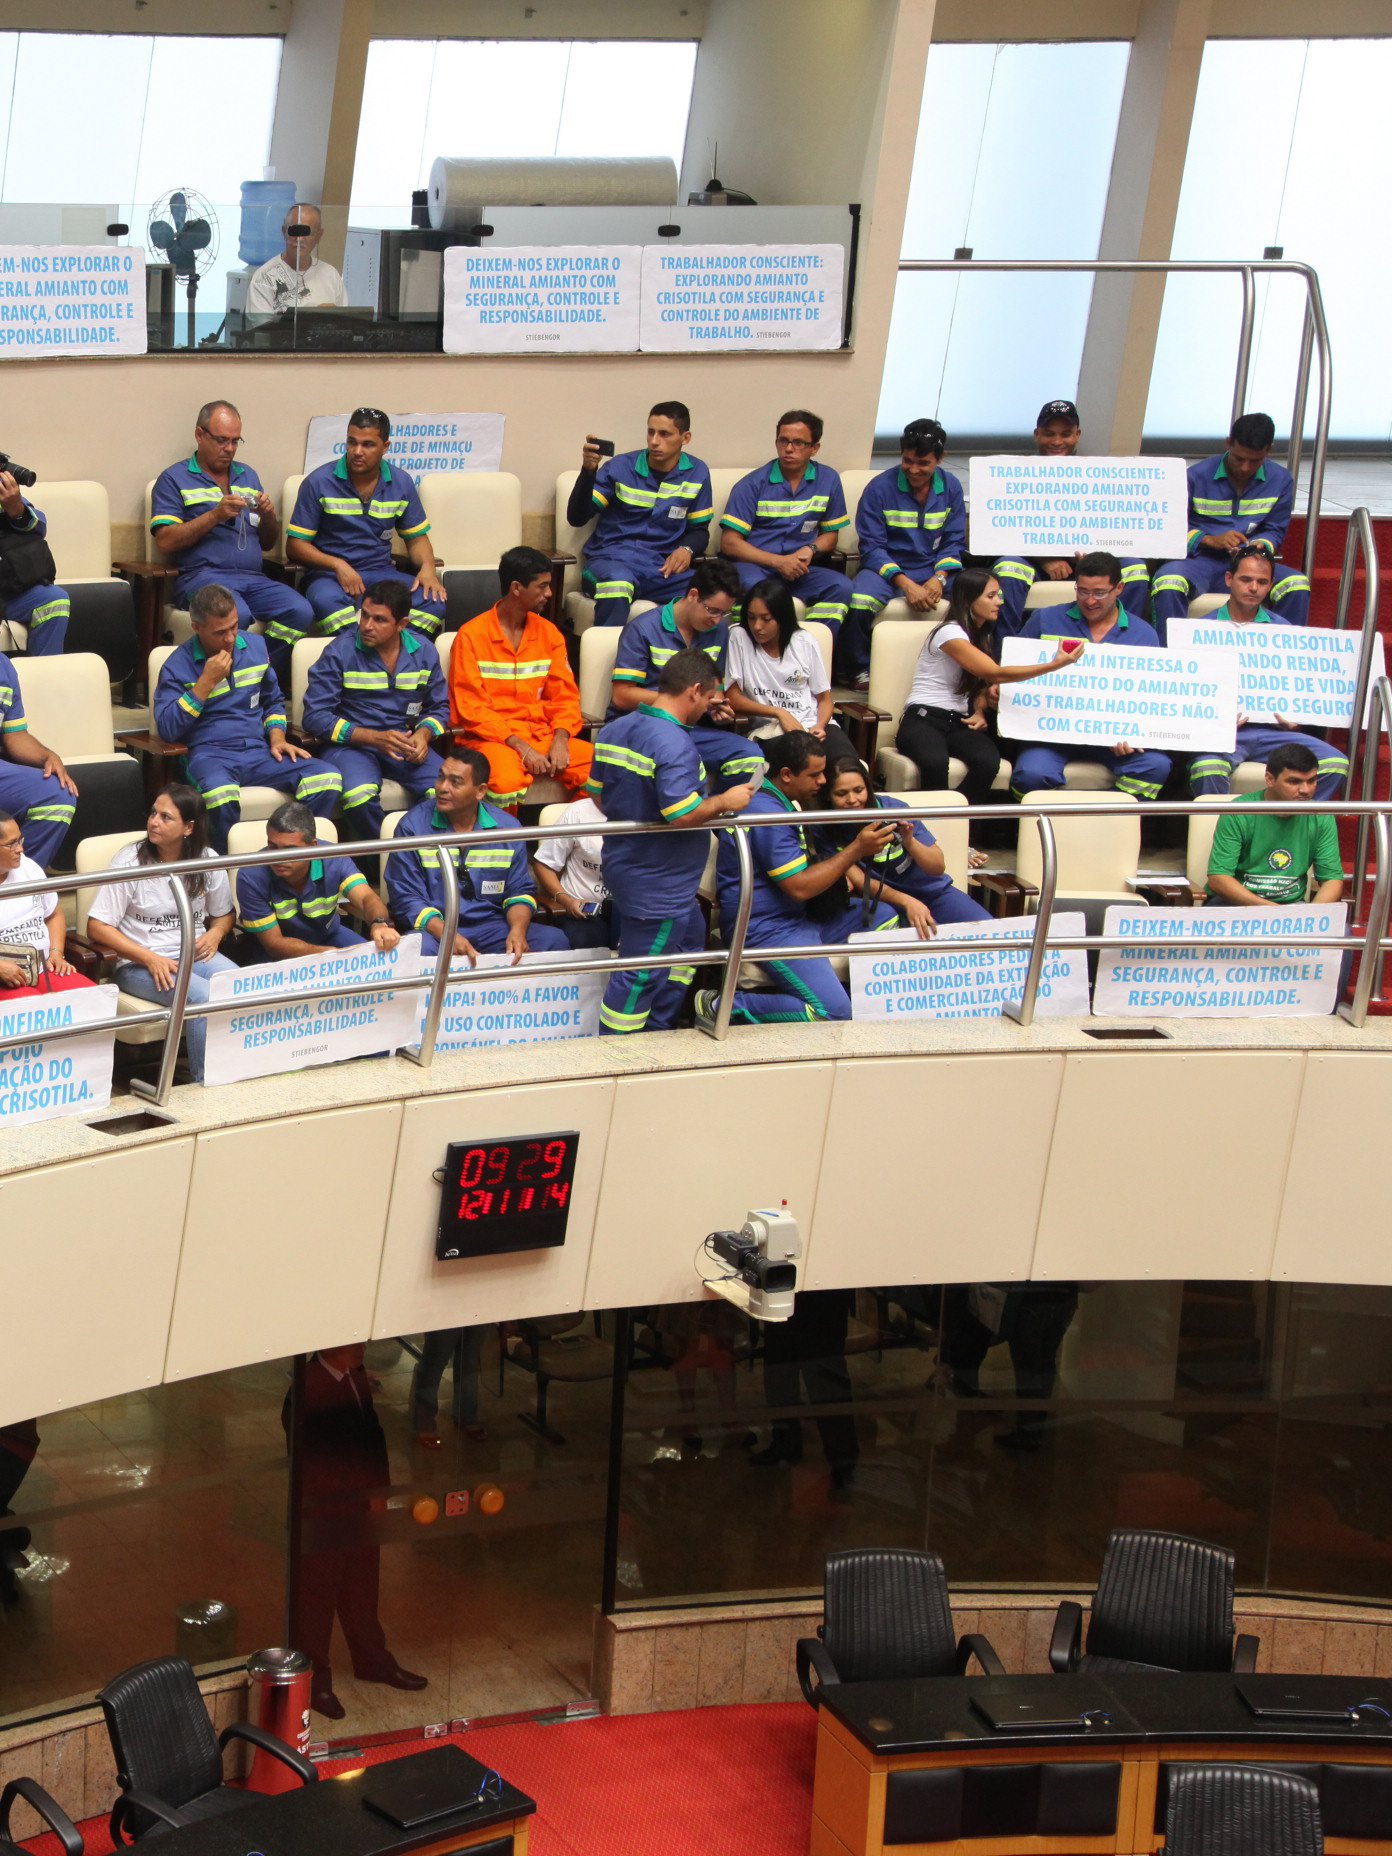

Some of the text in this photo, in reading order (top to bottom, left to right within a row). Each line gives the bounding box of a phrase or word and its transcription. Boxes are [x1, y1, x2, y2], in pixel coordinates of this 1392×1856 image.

[53, 256, 120, 272] EXPLORAR
[124, 256, 132, 271] O
[466, 257, 620, 271] DEIXEM-NOS EXPLORAR O
[660, 256, 823, 269] TRABALHADOR CONSCIENTE:
[470, 275, 616, 289] MINERAL AMIANTO COM
[675, 273, 808, 286] EXPLORANDO AMIANTO
[35, 280, 97, 296] AMIANTO
[101, 280, 128, 295] COM
[466, 292, 620, 309] SEGURANÇA, CONTROLE E
[657, 291, 824, 306] CRISOTILA COM SEGURANÇA E
[55, 304, 122, 319] CONTROLE
[127, 303, 133, 318] E
[480, 309, 606, 323] RESPONSABILIDADE.
[661, 308, 819, 321] CONTROLE DO AMBIENTE DE
[689, 326, 753, 338] TRABALHO.
[451, 425, 457, 436] E
[411, 441, 472, 456] DE MINAÇU
[400, 458, 447, 469] PROJETO
[451, 458, 465, 469] DE
[989, 466, 1165, 480] TRABALHADOR CONSCIENTE:
[1006, 483, 1150, 496] EXPLORANDO AMIANTO
[987, 499, 1168, 516] CRISOTILA COM SEGURANÇA E
[992, 516, 1163, 530] CONTROLE DO AMBIENTE DE
[1023, 533, 1093, 545] TRABALHO.
[1193, 630, 1354, 653] AMIANTO CRISOTILA
[1038, 651, 1198, 674] A INTERESSA O
[1287, 656, 1346, 675] RENDA,
[1016, 673, 1218, 697] ANIMENTO DO AMIANTO?
[1294, 677, 1314, 692] DE
[1012, 693, 1219, 720] AOS TRABALHADORES NÃO.
[1038, 716, 1190, 740] COM CERTEZA. STIEBENGOR
[1119, 916, 1330, 936] DEIXEM-NOS EXPLORAR O
[234, 965, 316, 995] DEIXEM-NOS
[320, 951, 386, 978] EXPLORAR
[389, 949, 398, 963] O
[872, 952, 994, 977] COLABORADORES
[865, 971, 994, 996] CONTINUIDADE DA
[1112, 964, 1323, 987] SEGURANÇA, CONTROLE E
[480, 986, 579, 1005] 100% A FAVOR
[1128, 989, 1300, 1006] RESPONSABILIDADE.
[886, 999, 892, 1012] E
[230, 1005, 313, 1033] SEGURANÇA,
[445, 1016, 473, 1032] USO
[477, 1011, 570, 1031] CONTROLADO
[574, 1010, 580, 1025] E
[244, 1009, 378, 1049] RESPONSABILIDADE.
[291, 1045, 328, 1058] STIEBENGOR
[49, 1057, 72, 1079] DO
[0, 1080, 93, 1115] CRISOTILA.
